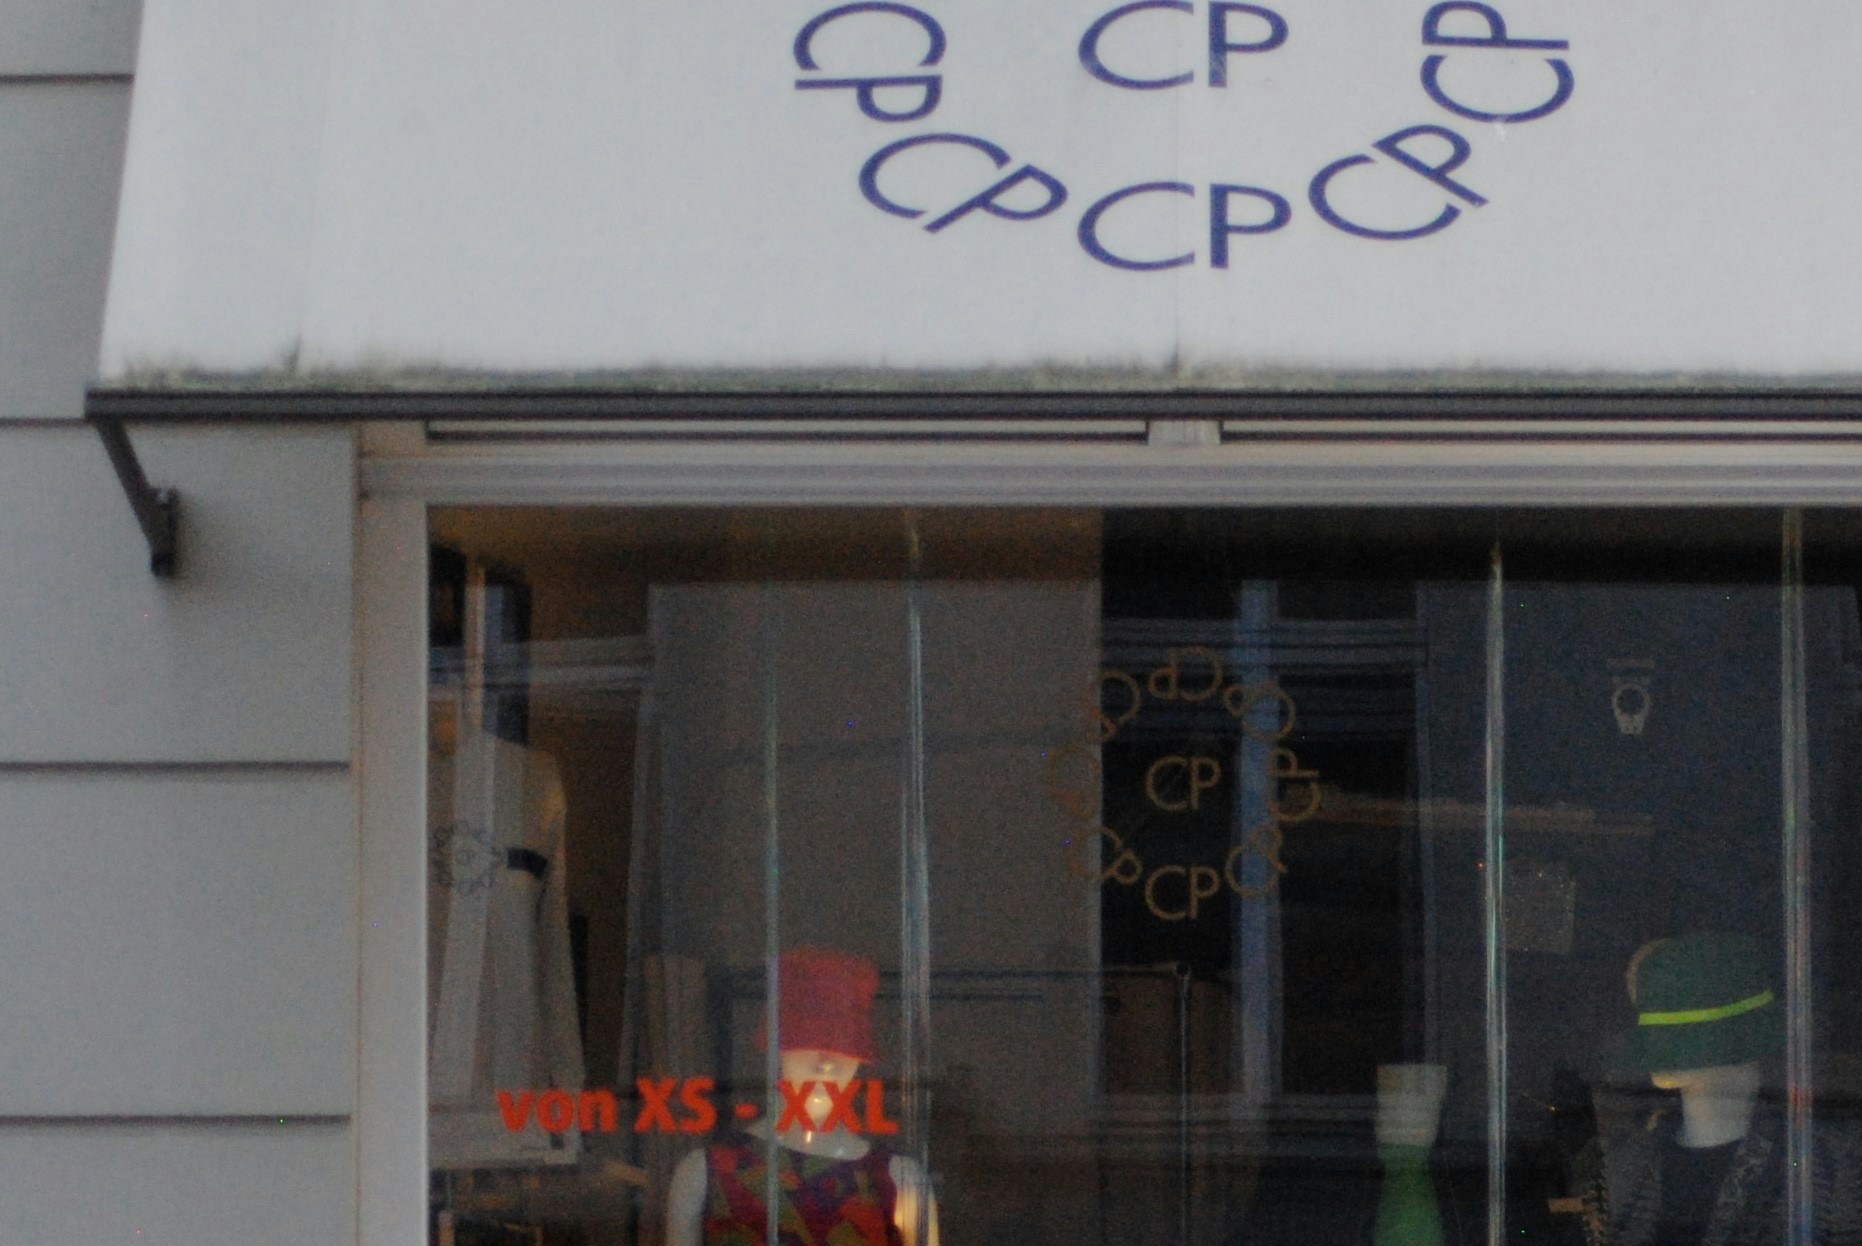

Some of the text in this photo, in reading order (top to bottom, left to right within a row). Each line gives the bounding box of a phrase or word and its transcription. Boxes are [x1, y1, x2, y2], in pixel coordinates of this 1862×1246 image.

[793, 1, 946, 122] CP
[1078, 0, 1289, 90] CP
[1420, 0, 1574, 124] CP
[858, 133, 1068, 234] CP
[1077, 182, 1292, 271] CP
[1308, 124, 1490, 241] CP
[1145, 755, 1221, 811] CP
[1145, 865, 1221, 921] CP
[497, 1088, 617, 1134] von
[633, 1076, 717, 1134] XS
[774, 1079, 898, 1134] XXL
